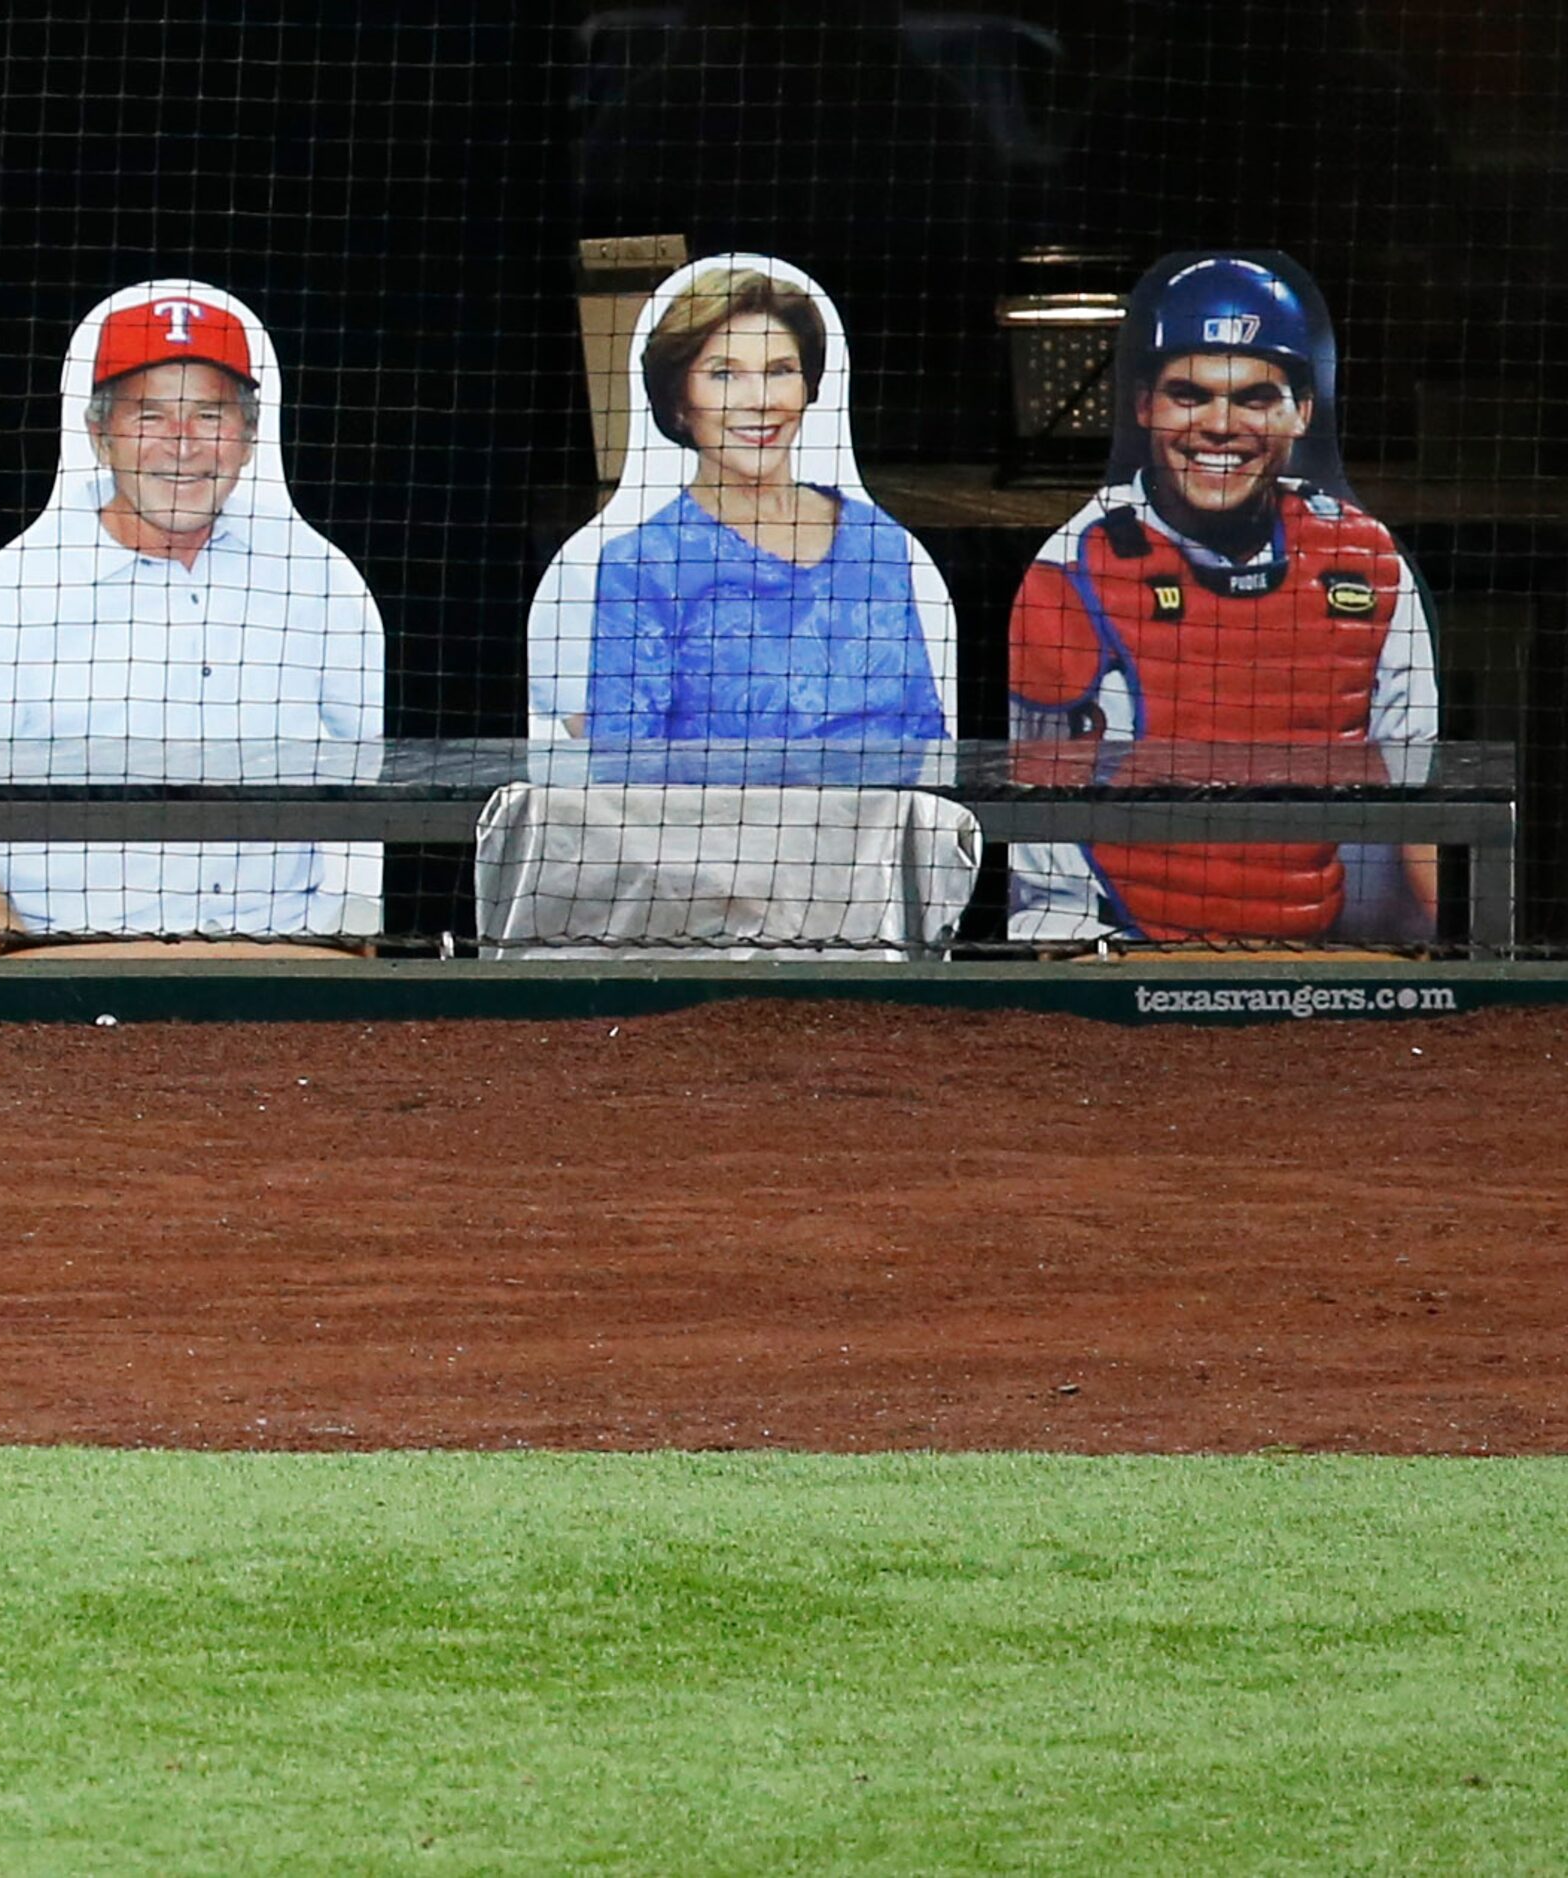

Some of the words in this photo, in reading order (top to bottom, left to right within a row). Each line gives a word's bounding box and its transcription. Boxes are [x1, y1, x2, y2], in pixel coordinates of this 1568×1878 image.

[152, 301, 205, 344] T
[1241, 313, 1260, 344] 7
[1134, 985, 1457, 1018] texasrangers.com
